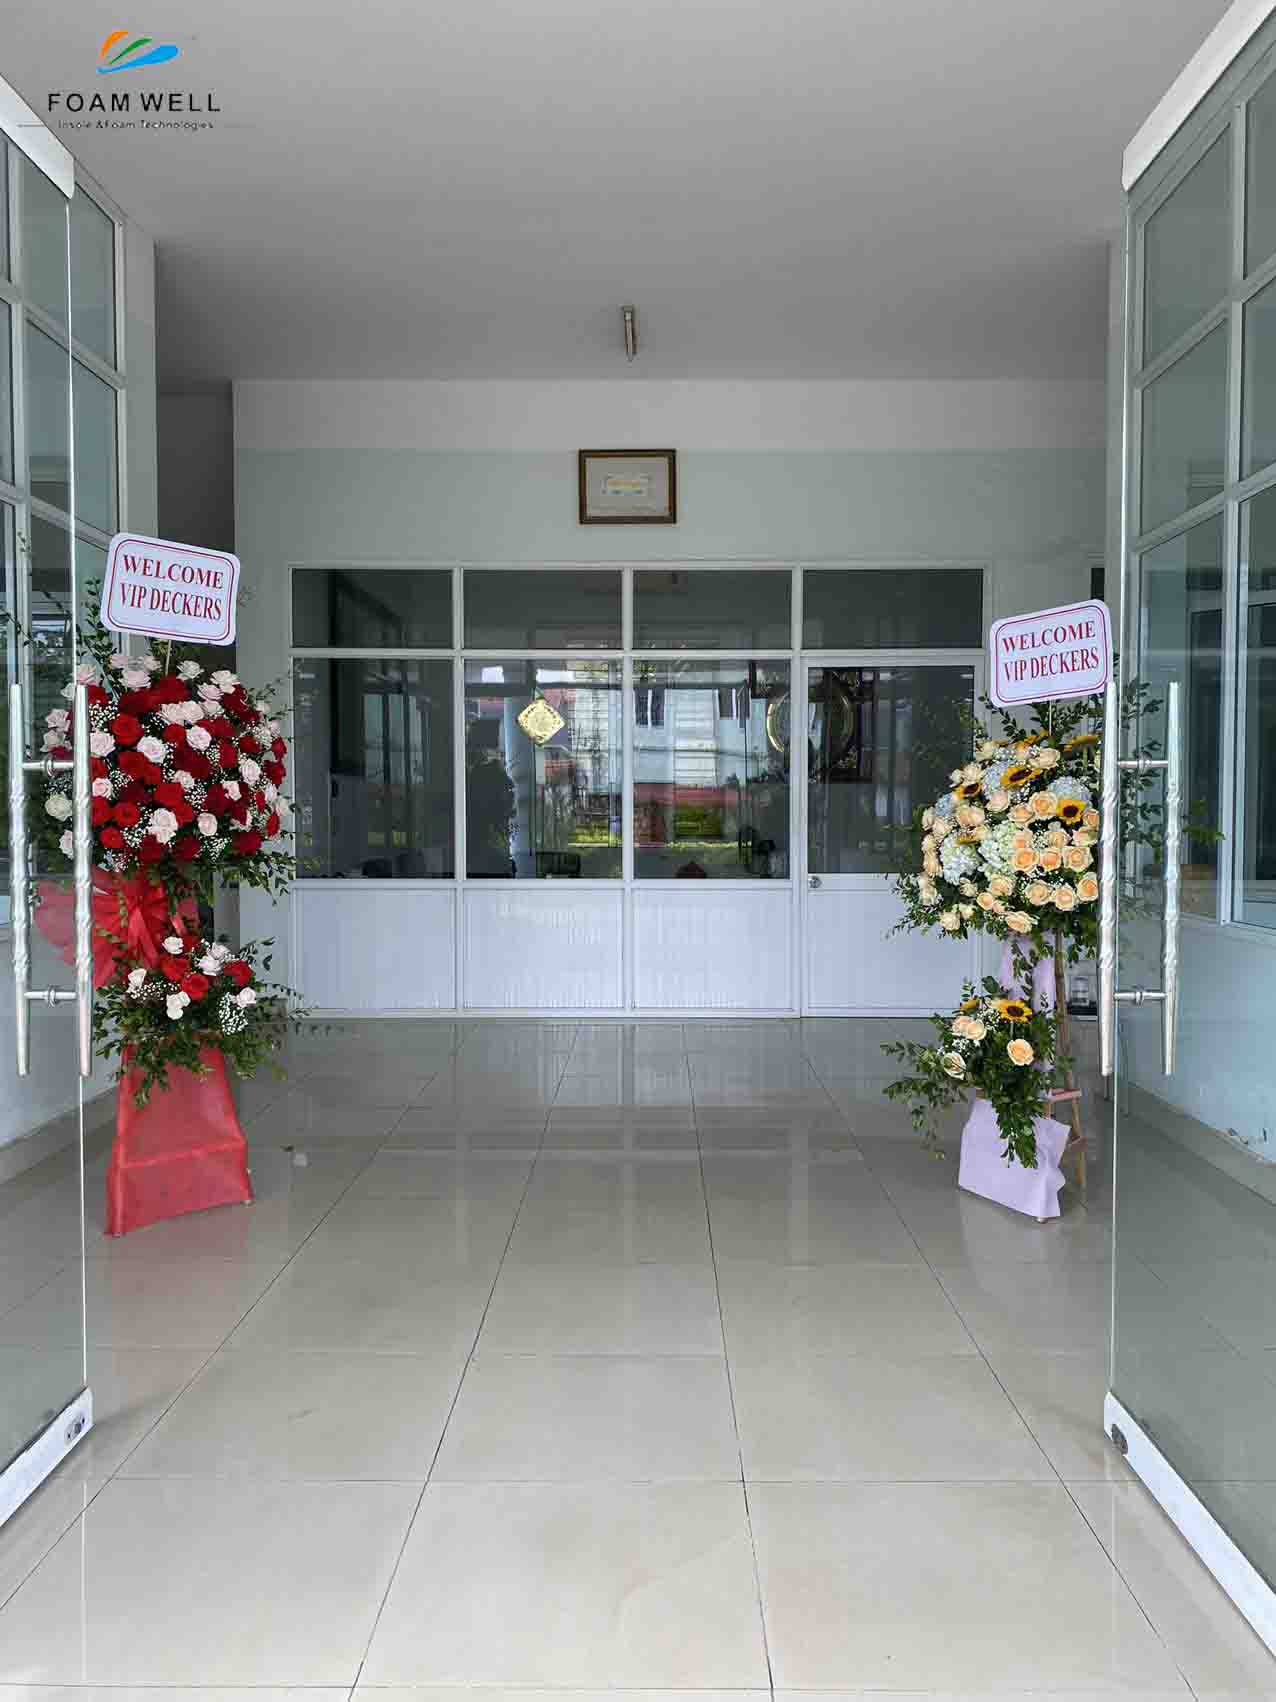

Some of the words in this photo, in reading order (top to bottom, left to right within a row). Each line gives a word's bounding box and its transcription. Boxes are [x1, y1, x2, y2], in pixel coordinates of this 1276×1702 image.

[122, 554, 224, 589] WELCOME
[119, 582, 147, 609] VIP
[149, 587, 222, 621] DECKERS
[1002, 620, 1096, 653] WELCOME
[1004, 659, 1027, 681] VIP
[1030, 646, 1099, 679] DECKERS
